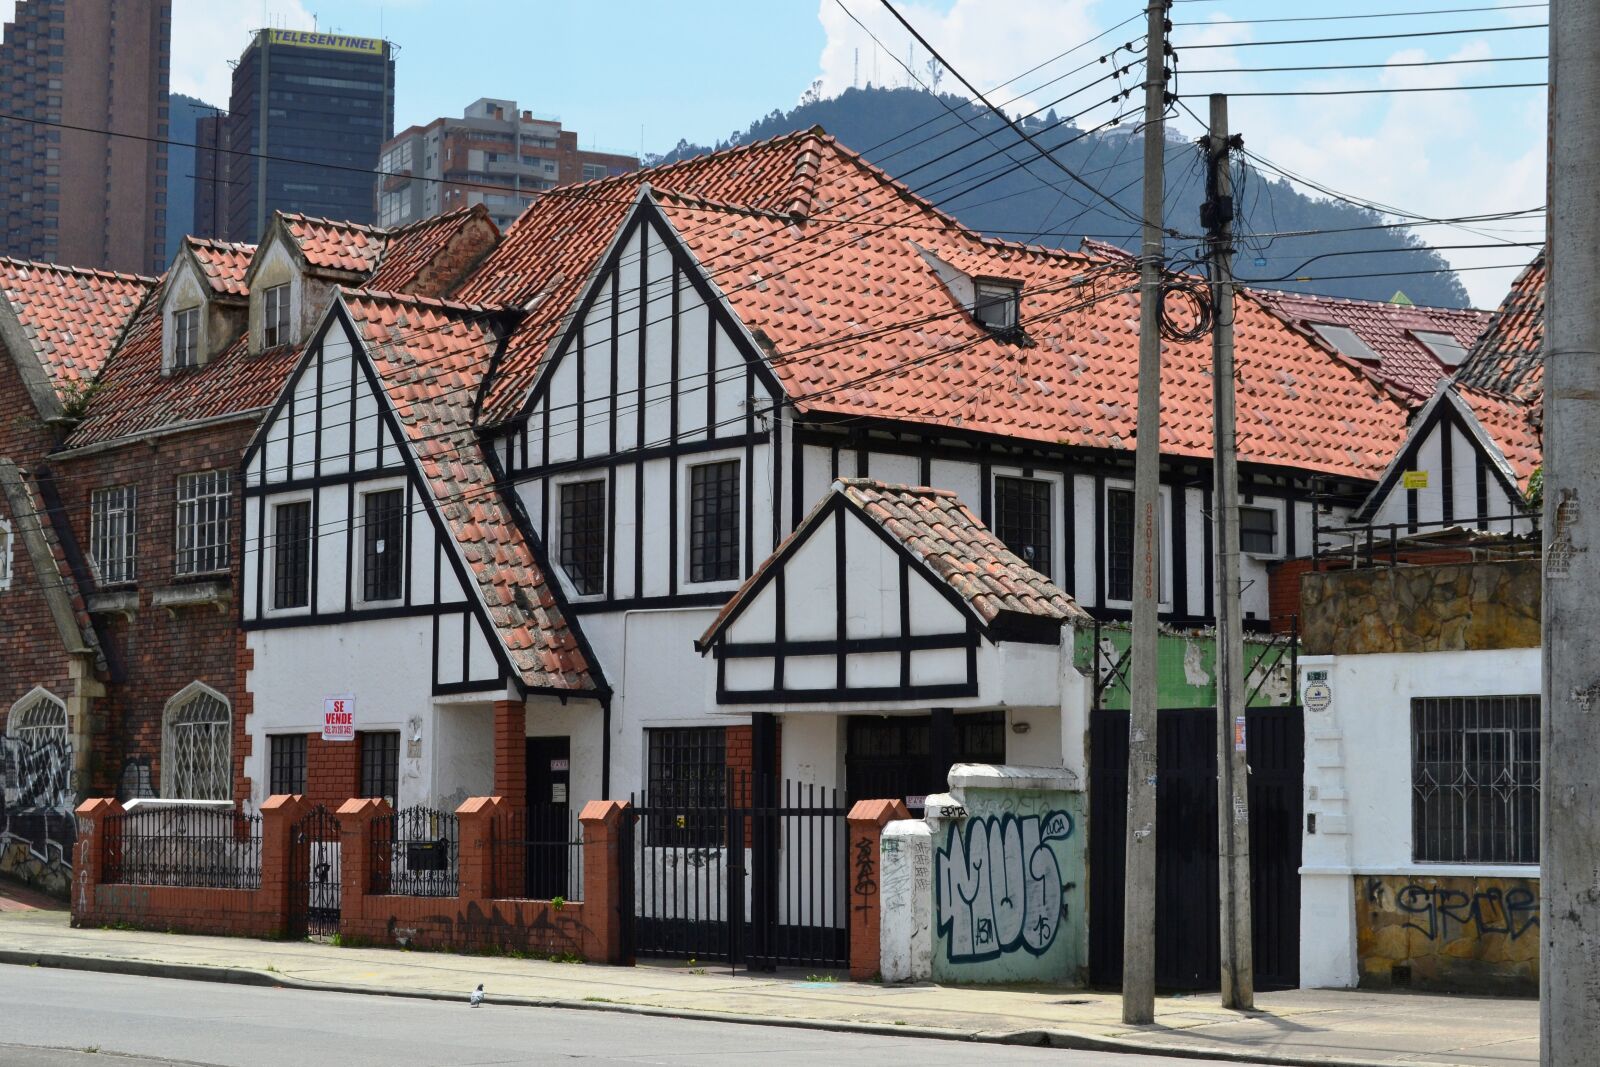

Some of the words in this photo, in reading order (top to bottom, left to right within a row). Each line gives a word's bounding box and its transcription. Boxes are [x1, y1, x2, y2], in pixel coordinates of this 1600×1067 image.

[273, 30, 376, 50] TELESENTINEL
[333, 700, 345, 713] SE
[325, 713, 353, 725] VENDE
